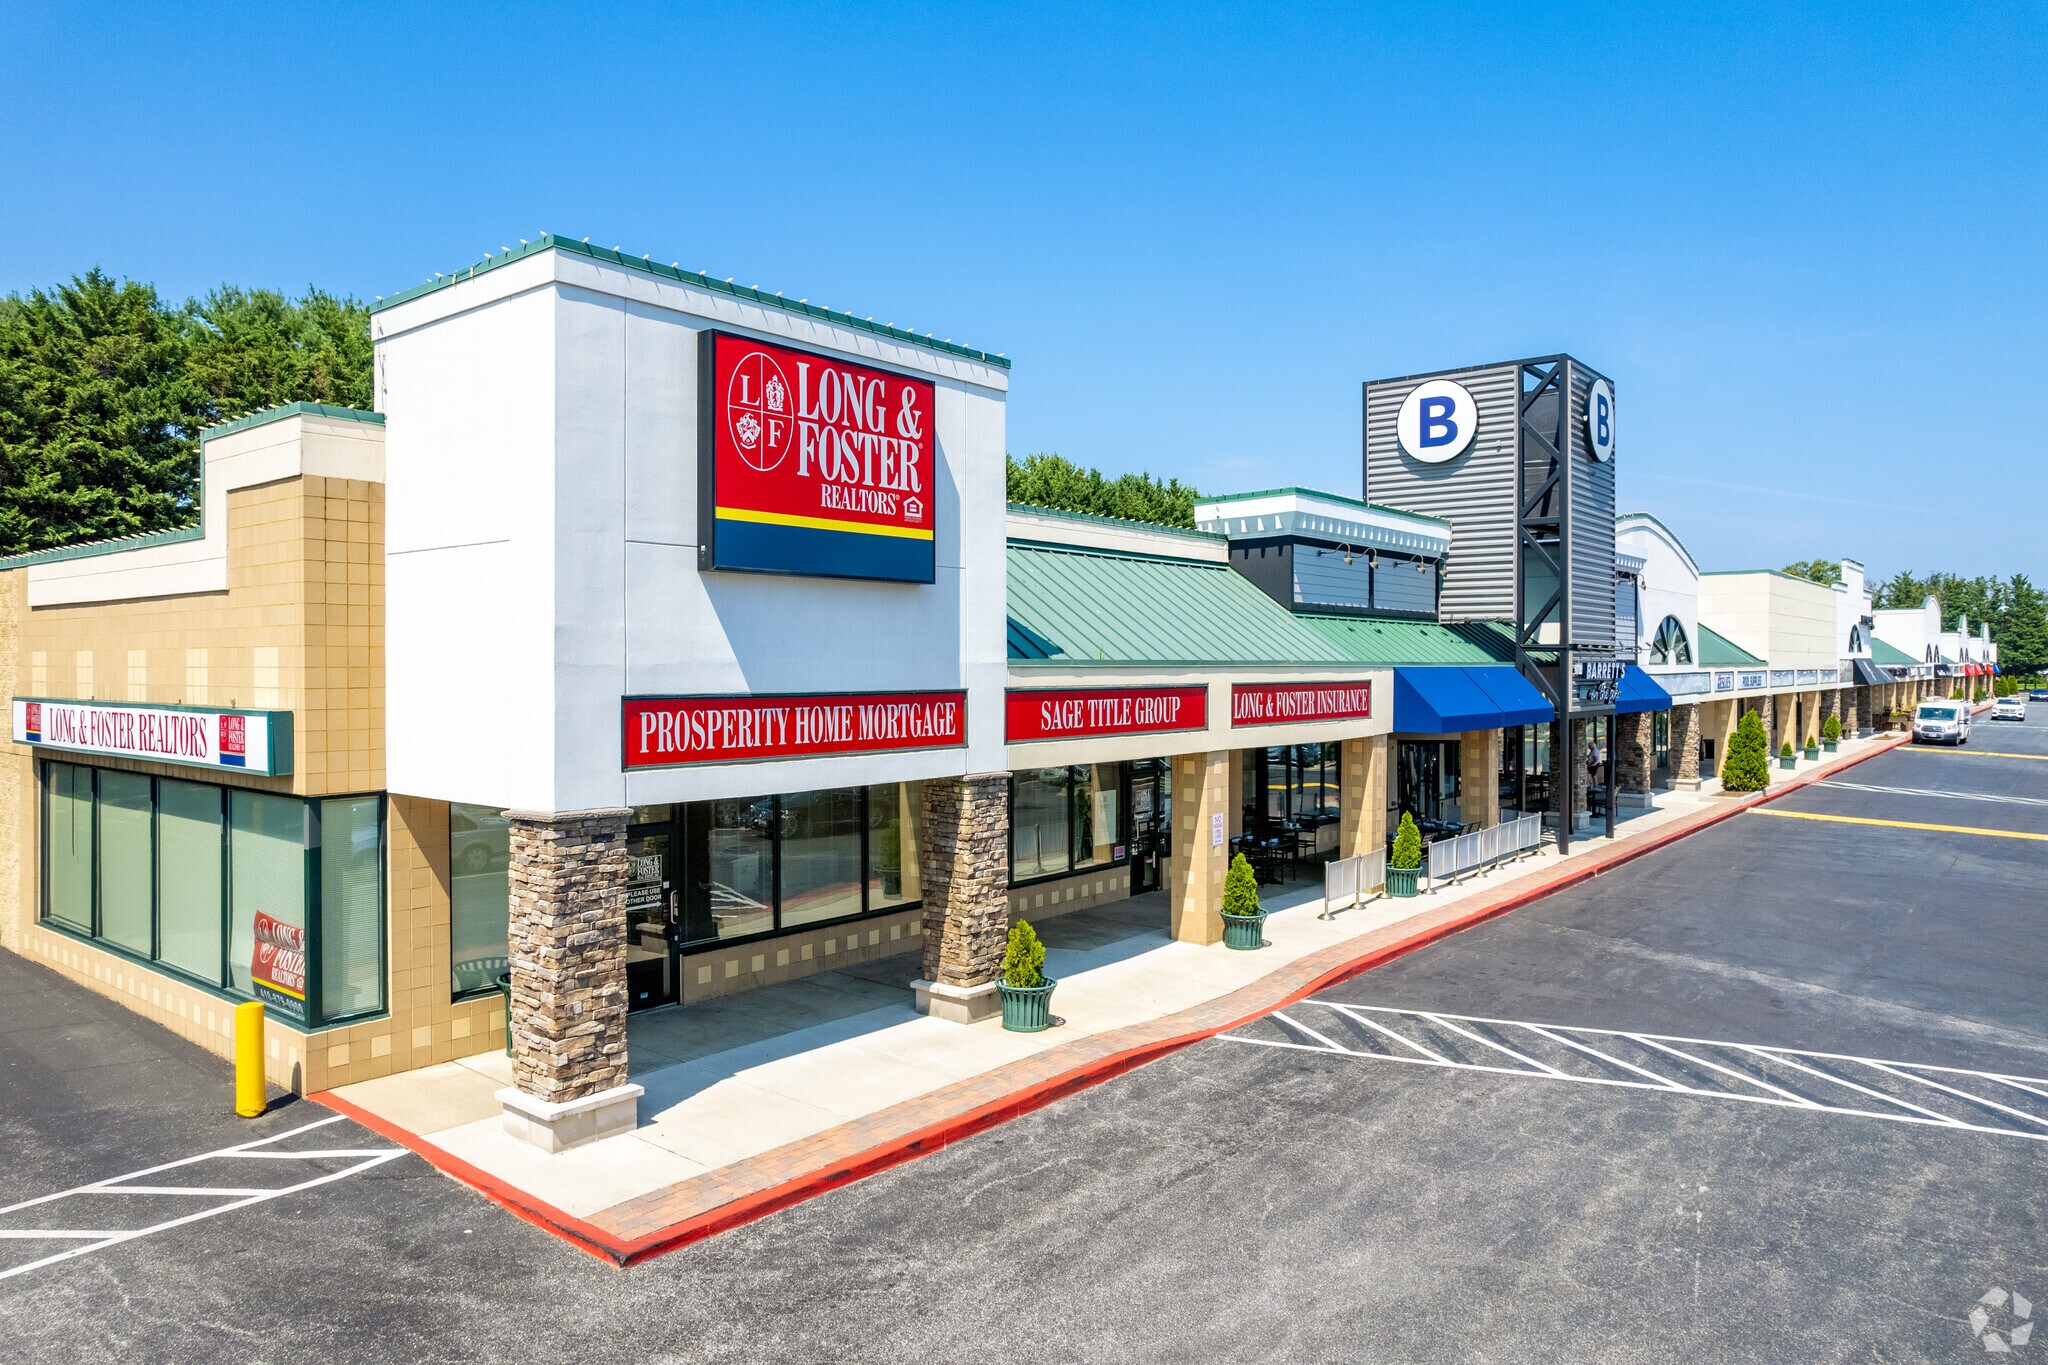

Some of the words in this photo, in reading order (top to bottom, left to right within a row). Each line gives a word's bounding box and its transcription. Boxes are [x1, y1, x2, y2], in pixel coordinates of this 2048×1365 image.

[740, 374, 760, 406] L
[796, 361, 886, 433] LONG
[897, 386, 923, 440] &
[768, 419, 785, 448] F
[1419, 395, 1458, 448] B
[1597, 393, 1610, 447] B
[1041, 700, 1084, 731] SAGE
[1087, 697, 1132, 728] TITLE
[1134, 696, 1181, 725] GROUP
[1233, 692, 1264, 719] LONG
[1265, 694, 1274, 717] &
[1275, 691, 1316, 717] FOSTER
[1316, 688, 1368, 714] INSURANCE
[49, 708, 76, 744] LONG
[78, 710, 87, 745] &
[90, 711, 135, 750] FOSTER
[138, 714, 208, 758] REALTORS
[639, 707, 790, 754] PROSPERITY
[795, 705, 854, 745] HOME
[858, 702, 957, 741] MORTGAGE
[626, 896, 645, 905] OTHER
[645, 894, 662, 902] DOOR
[272, 922, 298, 950] LONG
